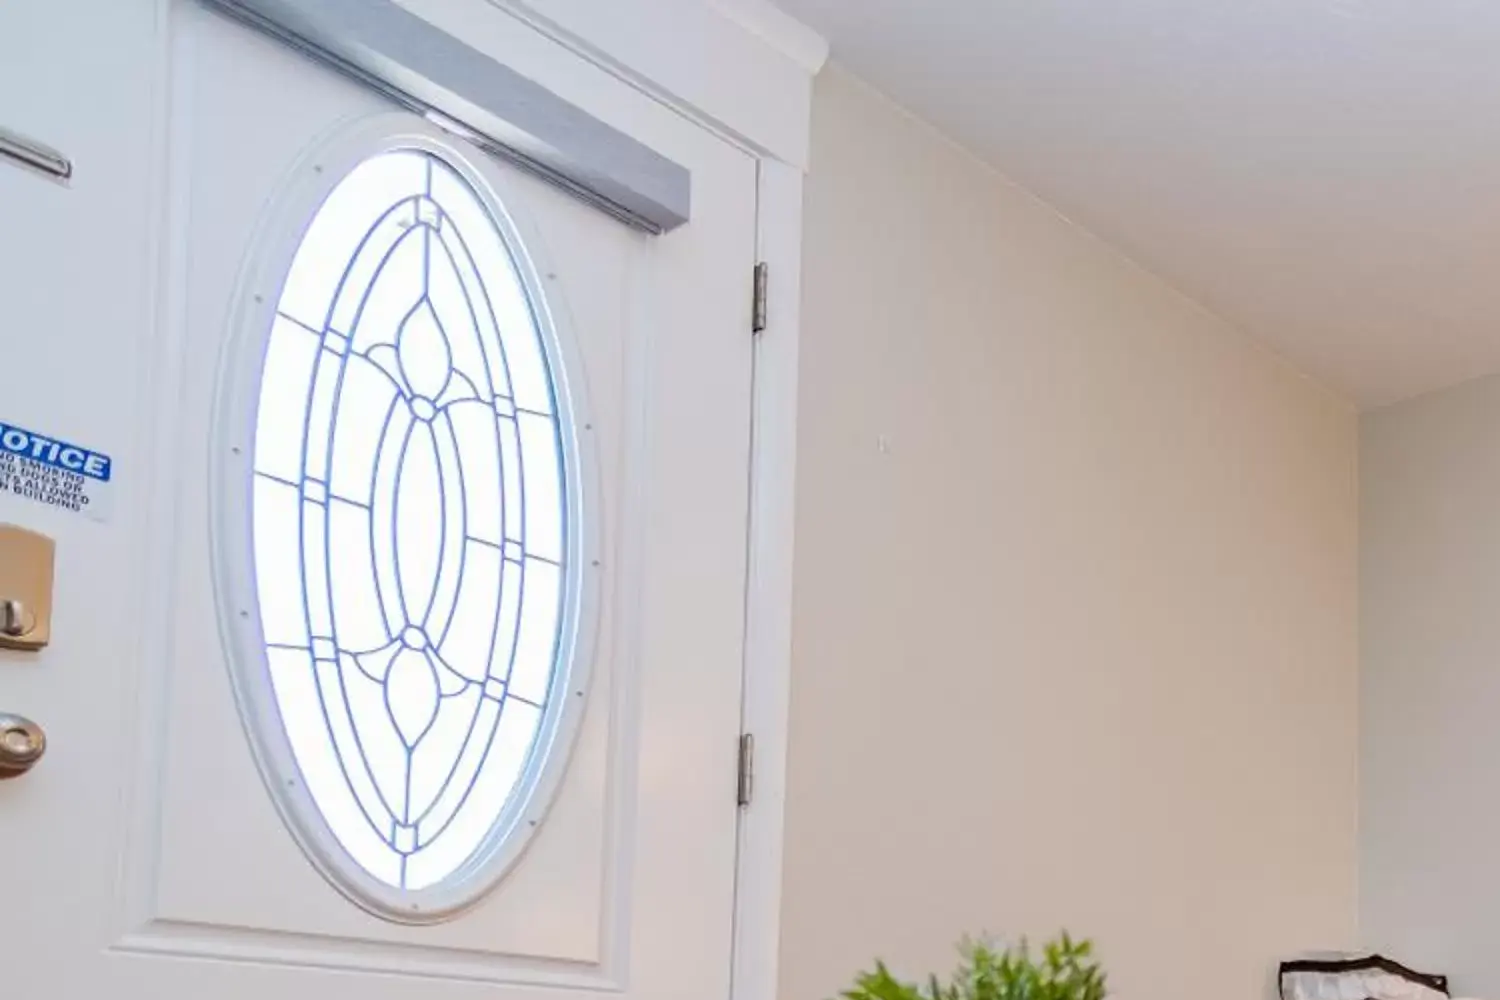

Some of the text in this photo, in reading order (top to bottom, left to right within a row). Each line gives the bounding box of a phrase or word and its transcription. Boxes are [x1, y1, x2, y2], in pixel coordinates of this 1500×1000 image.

[0, 426, 108, 477] OTICE
[14, 482, 80, 512] BUILDING
[25, 479, 89, 505] ALLOWED
[64, 481, 82, 493] OR
